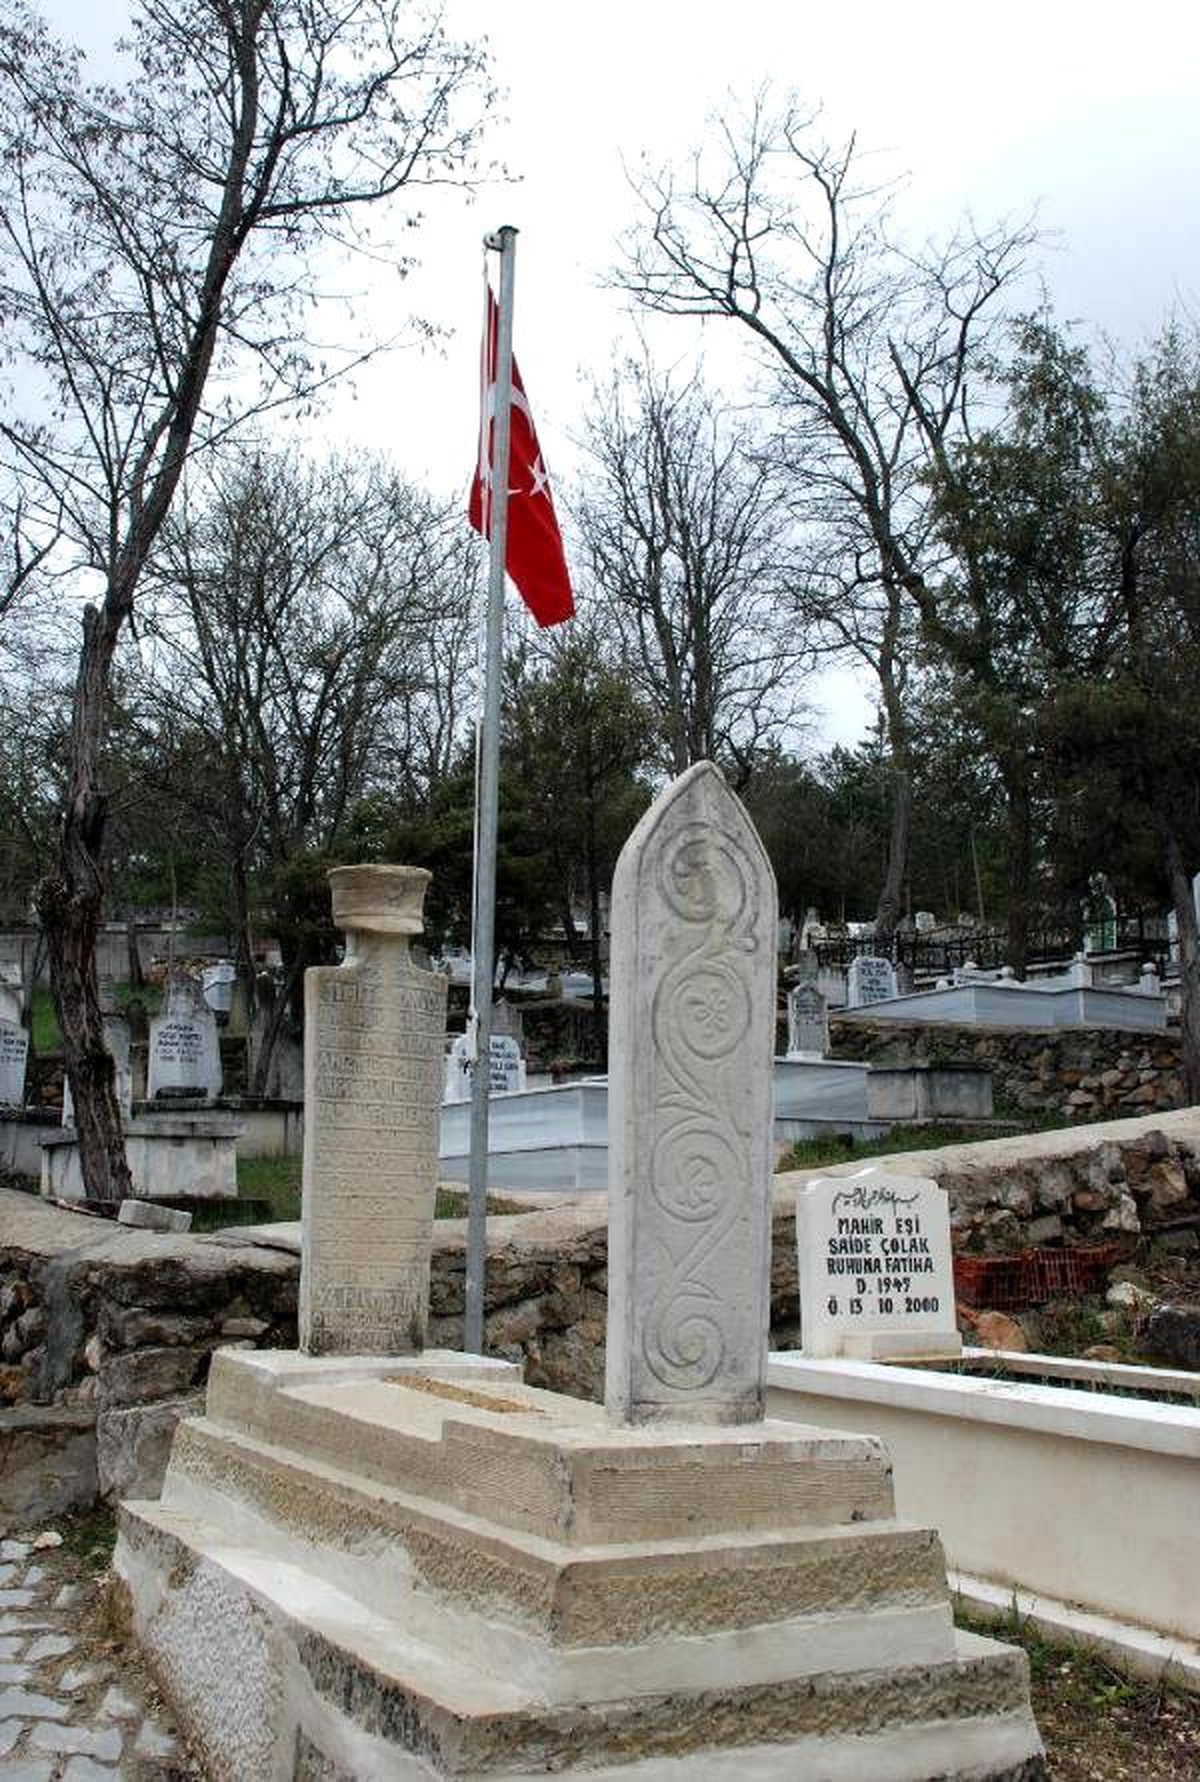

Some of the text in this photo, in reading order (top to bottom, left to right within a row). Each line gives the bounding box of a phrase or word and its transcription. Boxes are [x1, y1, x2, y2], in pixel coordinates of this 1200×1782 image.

[837, 1213, 920, 1236] MAHİR EŞİ
[828, 1235, 930, 1256] SAİDE ÇOLAK
[827, 1257, 882, 1275] RUHUNA
